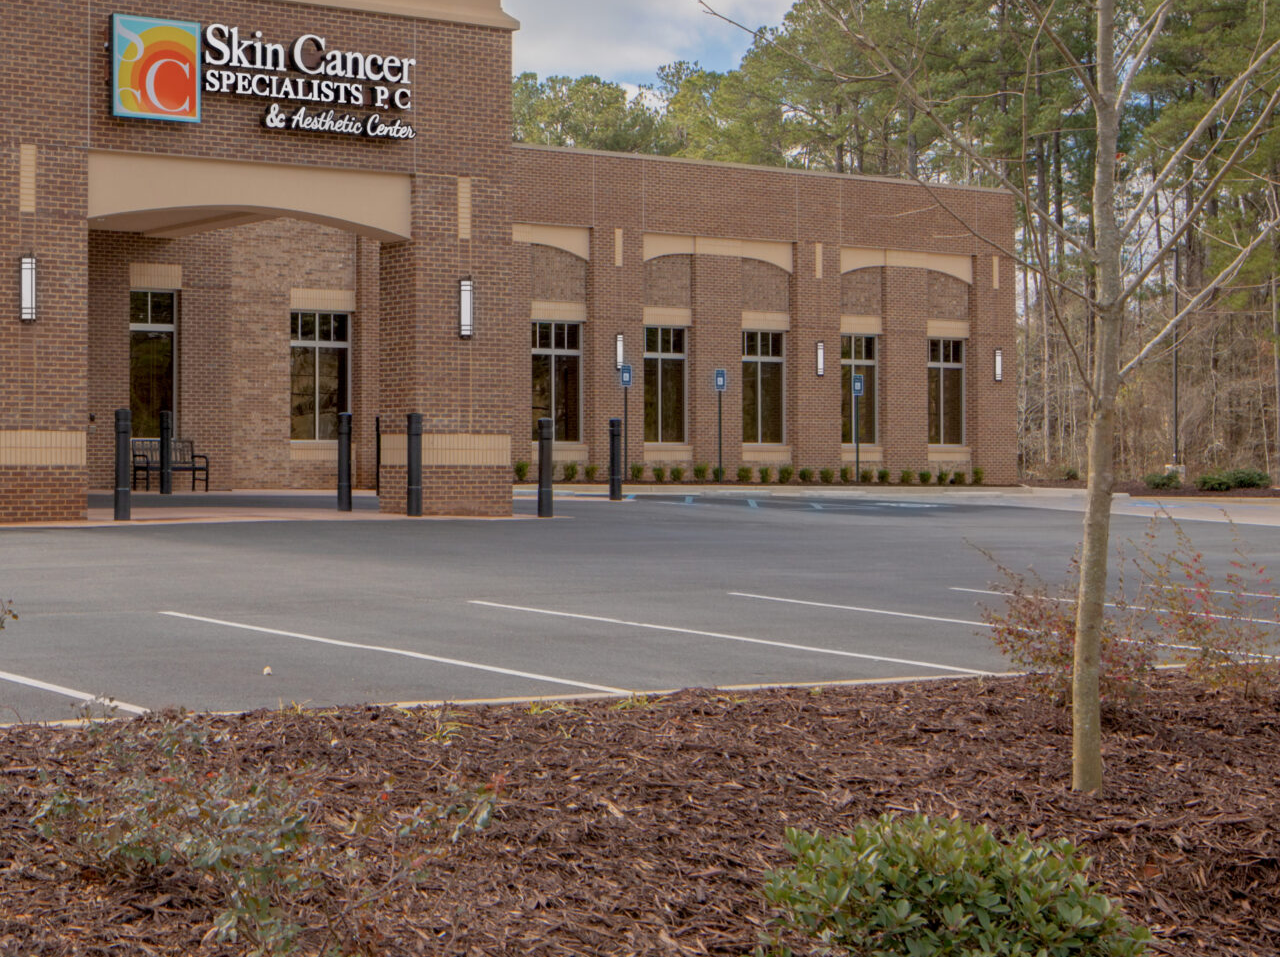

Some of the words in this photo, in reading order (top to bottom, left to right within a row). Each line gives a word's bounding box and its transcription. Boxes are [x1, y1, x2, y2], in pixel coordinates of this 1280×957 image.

[205, 23, 287, 72] Skin
[293, 33, 418, 84] Cancer
[205, 69, 364, 105] SPECIALISTS
[265, 103, 286, 128] &
[291, 106, 363, 134] Aesthetic
[366, 113, 417, 139] Center
